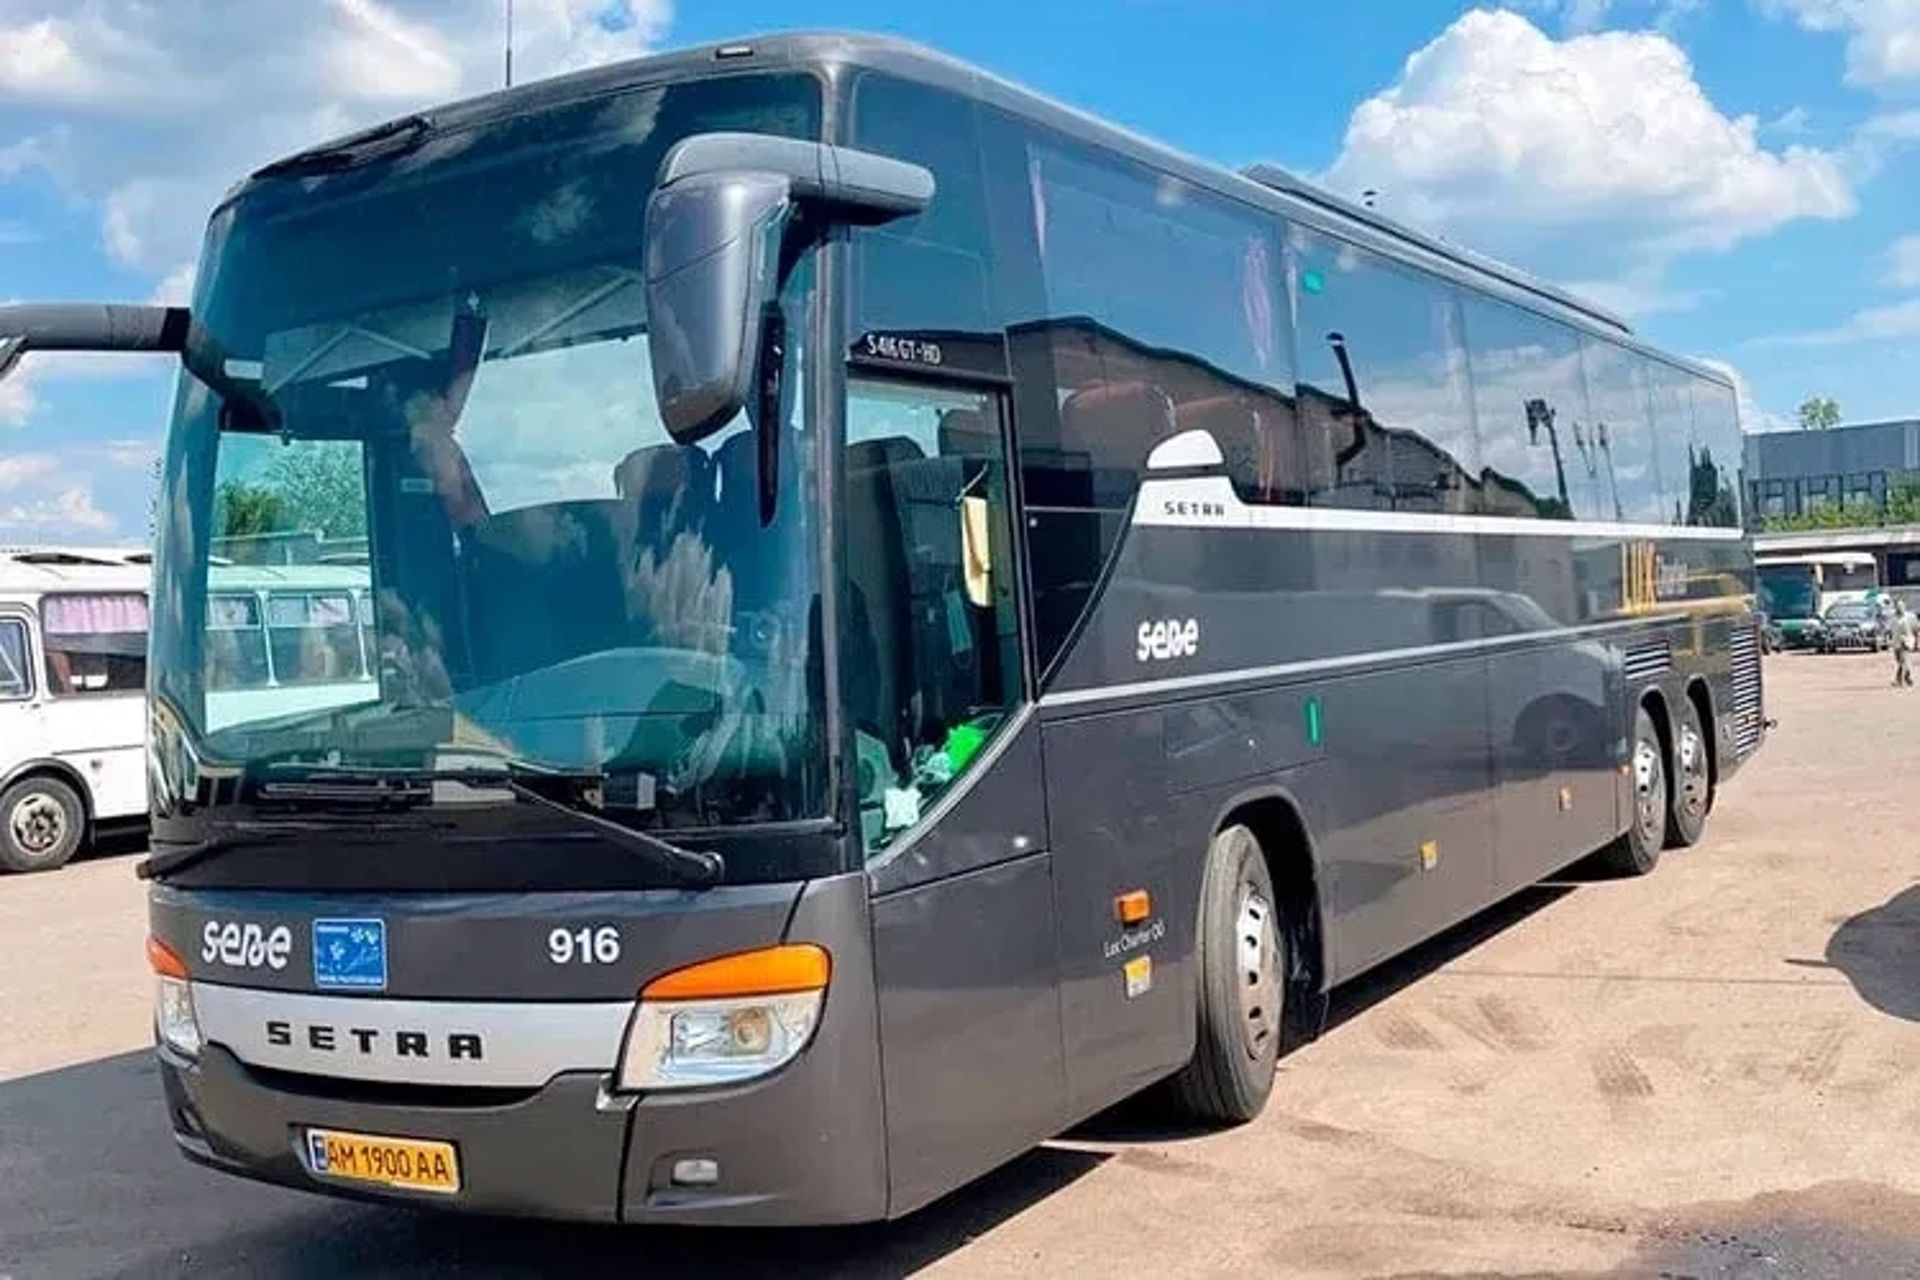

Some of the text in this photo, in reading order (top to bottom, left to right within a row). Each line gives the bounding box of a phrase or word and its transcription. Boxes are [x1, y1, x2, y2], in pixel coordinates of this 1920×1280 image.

[1164, 501, 1225, 516] SETRA
[549, 928, 621, 964] 916
[266, 1021, 484, 1060] SETRA
[328, 1141, 357, 1170] AM
[362, 1146, 410, 1177] 1900
[417, 1152, 449, 1180] AA
